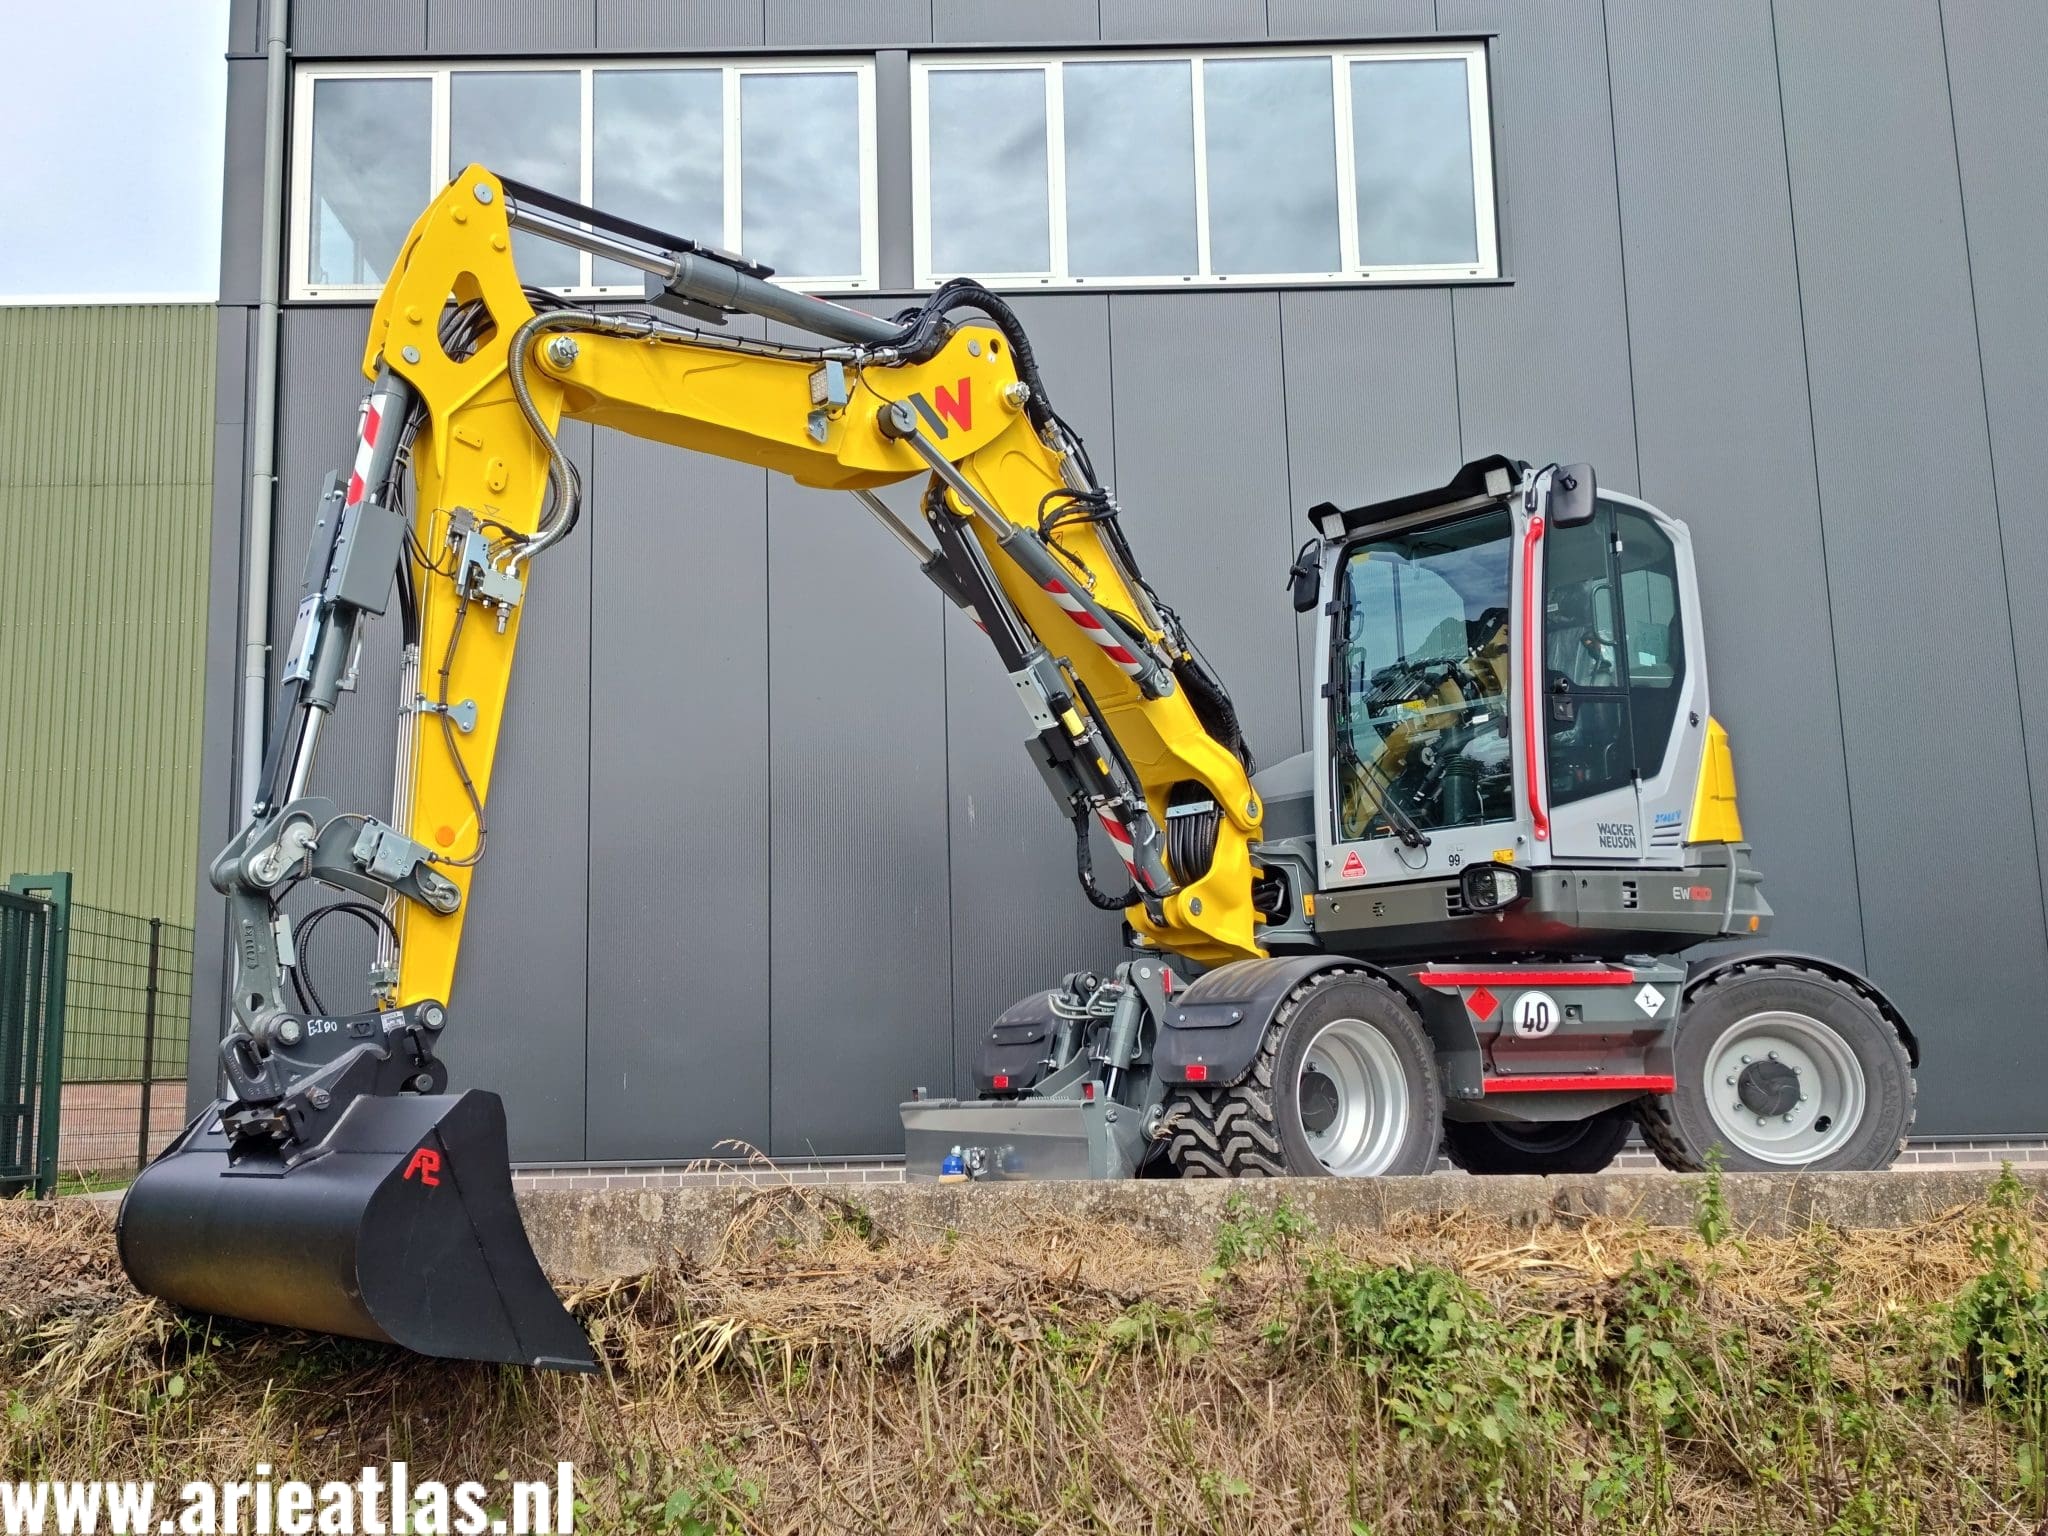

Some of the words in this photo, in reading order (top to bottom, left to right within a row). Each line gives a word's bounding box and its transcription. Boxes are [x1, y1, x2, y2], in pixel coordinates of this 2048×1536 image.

[1597, 822, 1635, 836] WACKER
[1599, 835, 1637, 849] NEUSON
[1448, 853, 1461, 867] 99
[1522, 1001, 1550, 1033] 40
